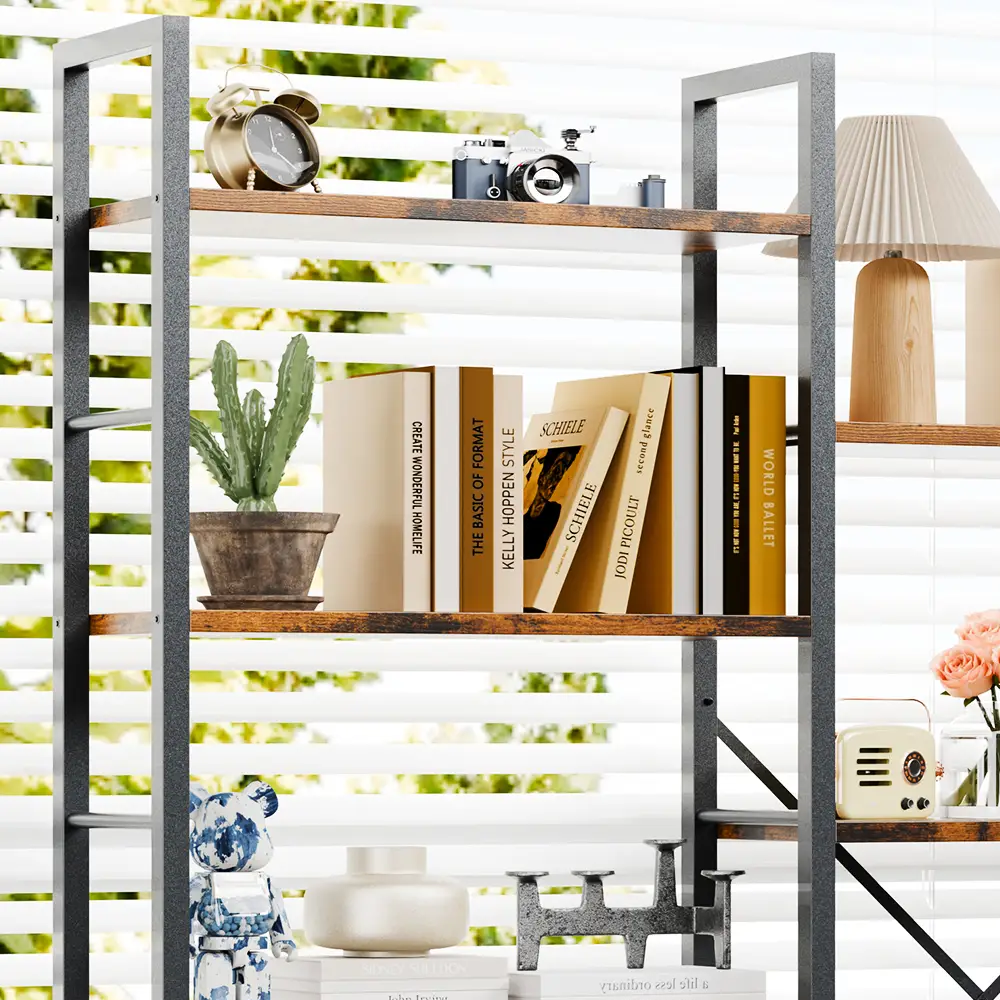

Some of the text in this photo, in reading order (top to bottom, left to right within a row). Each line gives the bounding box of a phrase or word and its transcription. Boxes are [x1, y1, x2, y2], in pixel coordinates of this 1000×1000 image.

[412, 421, 423, 555] CREATE WONDERFUL HOMELIFE
[472, 417, 484, 556] THE BASIC OF FORMAT
[539, 418, 586, 437] SCHIELE
[614, 407, 655, 579] JODI PICOULT second glance
[502, 428, 515, 570] KELLY HOPPEN STYLE
[565, 482, 598, 543] SCHIELE
[763, 448, 775, 548] WORLD BALLET
